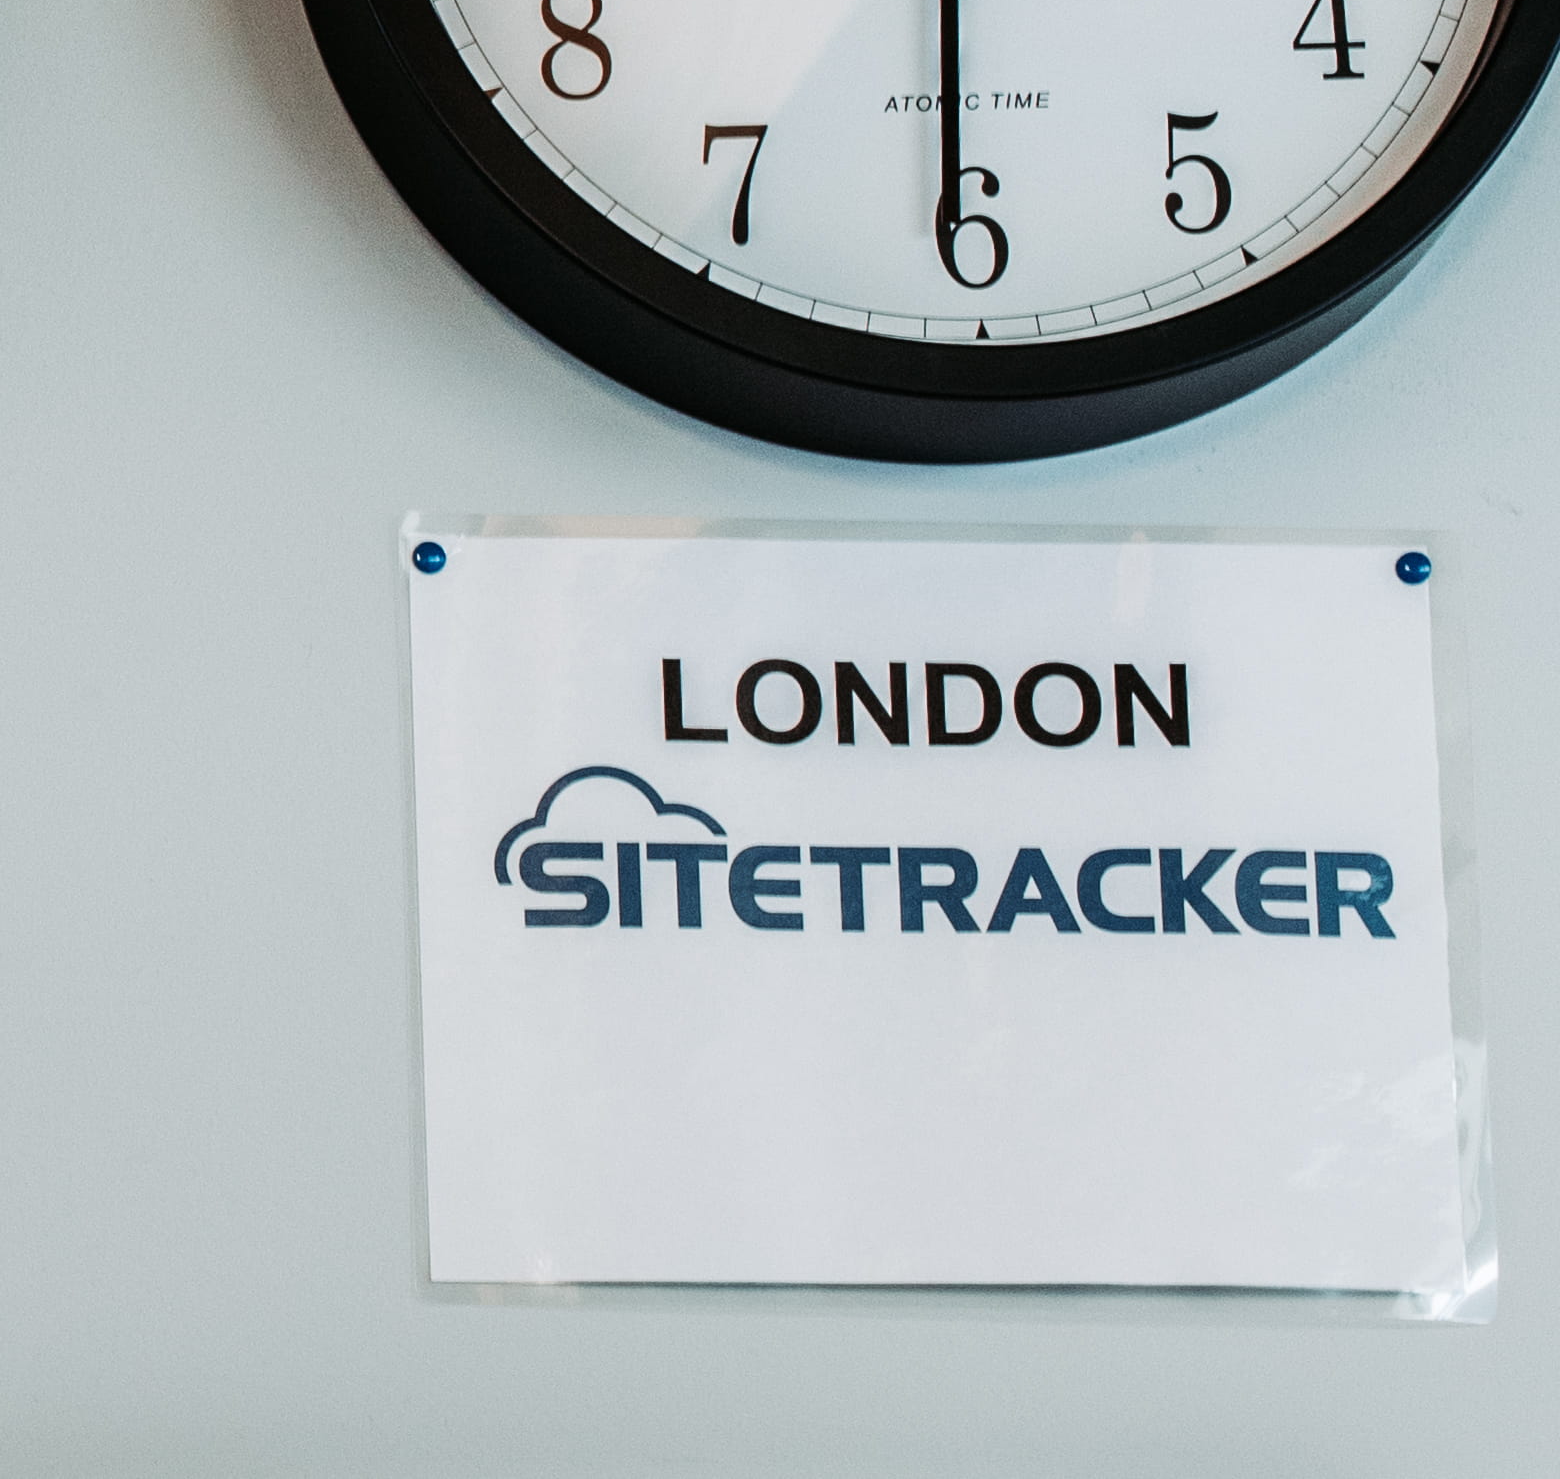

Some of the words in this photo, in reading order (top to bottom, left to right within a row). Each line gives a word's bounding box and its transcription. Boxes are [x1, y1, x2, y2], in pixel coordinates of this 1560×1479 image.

[884, 94, 980, 112] ATOC
[991, 92, 1050, 110] TIME
[703, 125, 768, 246] 7
[936, 165, 1008, 289] 6
[1165, 112, 1231, 234] 5
[663, 659, 1190, 747] LONDON
[518, 841, 1397, 940] SITETRACKER
